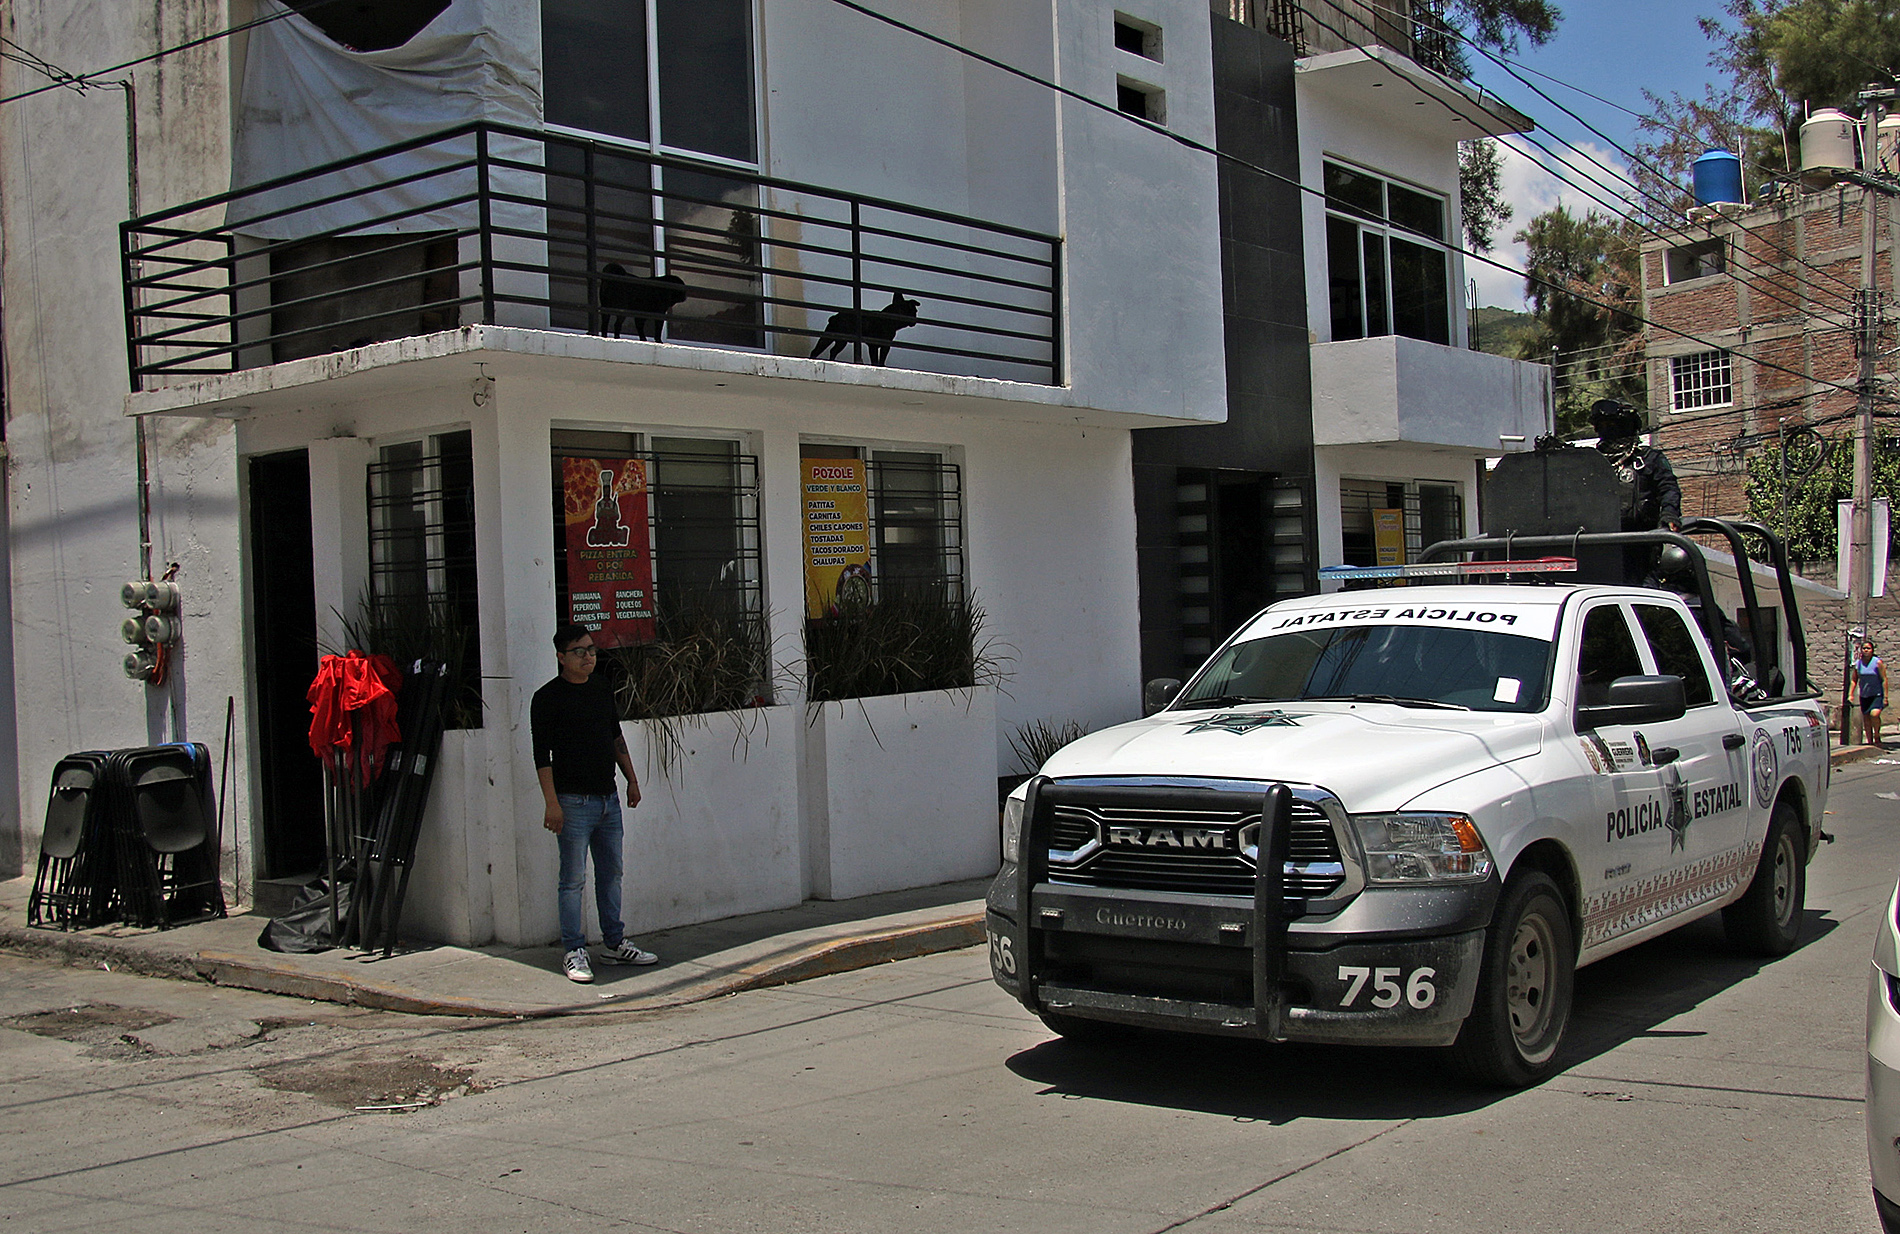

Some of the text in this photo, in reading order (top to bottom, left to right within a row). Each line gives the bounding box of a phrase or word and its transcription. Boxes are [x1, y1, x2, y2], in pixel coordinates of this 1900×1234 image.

[812, 467, 854, 479] POZOLE
[806, 484, 861, 493] VERDE Y BLANCO
[808, 501, 835, 509] PATITAS
[808, 512, 841, 520] CARNITAS
[809, 522, 863, 532] CHILES CAPONES
[810, 535, 844, 543] TOSTADAS
[811, 545, 864, 555] TACOS DORADOS
[580, 551, 605, 560] PIZZA
[596, 561, 602, 570] O
[812, 557, 846, 566] CHALUPAS
[616, 590, 644, 599] RANCHERA
[573, 603, 601, 612] PEPERONI
[573, 613, 596, 622] CARNES
[616, 610, 652, 619] VEGETARIANA
[1782, 725, 1802, 755] 756
[1606, 783, 1741, 842] POLICÍA ESTATAL
[1109, 826, 1226, 849] RAM
[1096, 907, 1186, 930] Guerrero
[1338, 965, 1436, 1009] 756
